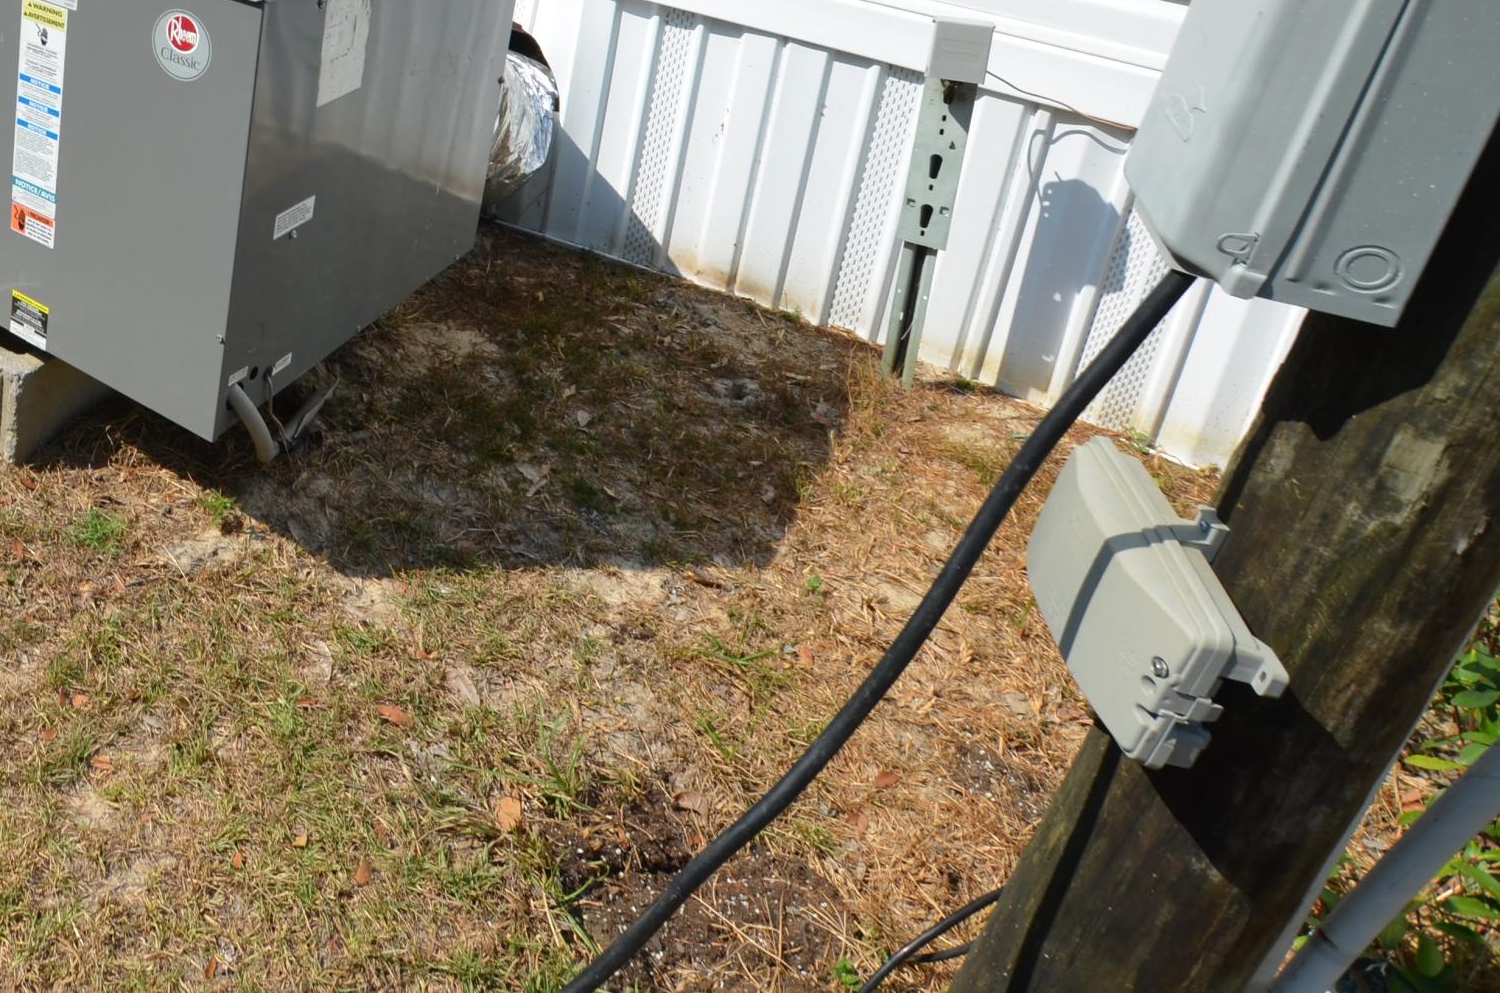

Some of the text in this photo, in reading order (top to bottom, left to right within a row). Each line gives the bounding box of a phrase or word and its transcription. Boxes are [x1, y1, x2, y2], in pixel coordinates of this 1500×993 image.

[33, 2, 63, 18] WARNING
[27, 12, 65, 29] AVERTISSEMENT
[170, 15, 197, 46] Rheem
[161, 47, 201, 71] Classic
[29, 77, 50, 90] NOTICE
[15, 178, 55, 202] NOTICE/AVIS
